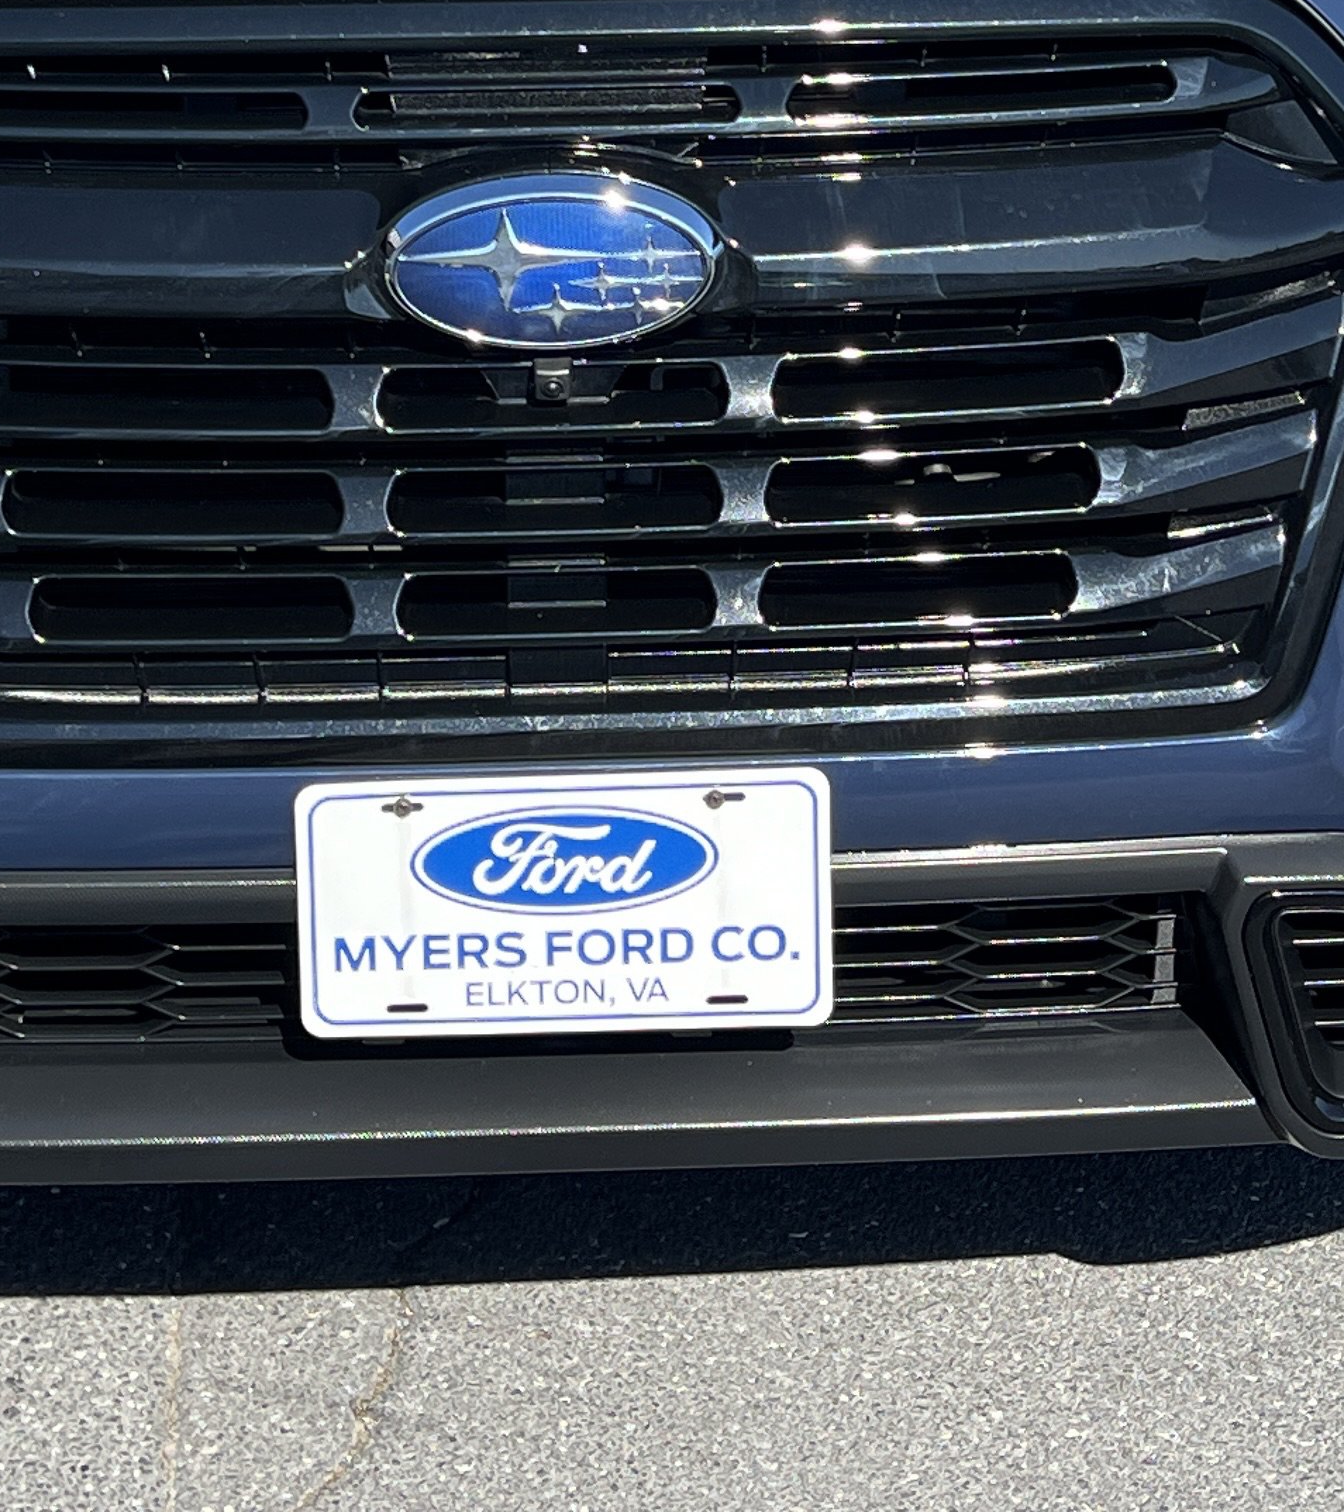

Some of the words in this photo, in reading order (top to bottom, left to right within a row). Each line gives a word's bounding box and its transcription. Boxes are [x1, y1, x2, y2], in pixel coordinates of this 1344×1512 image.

[471, 822, 658, 896] Ford
[334, 931, 527, 973] MYERS
[546, 927, 694, 966] FORD
[711, 924, 801, 962] CO.
[465, 979, 616, 1007] ELKTON,
[626, 977, 670, 1003] VA
